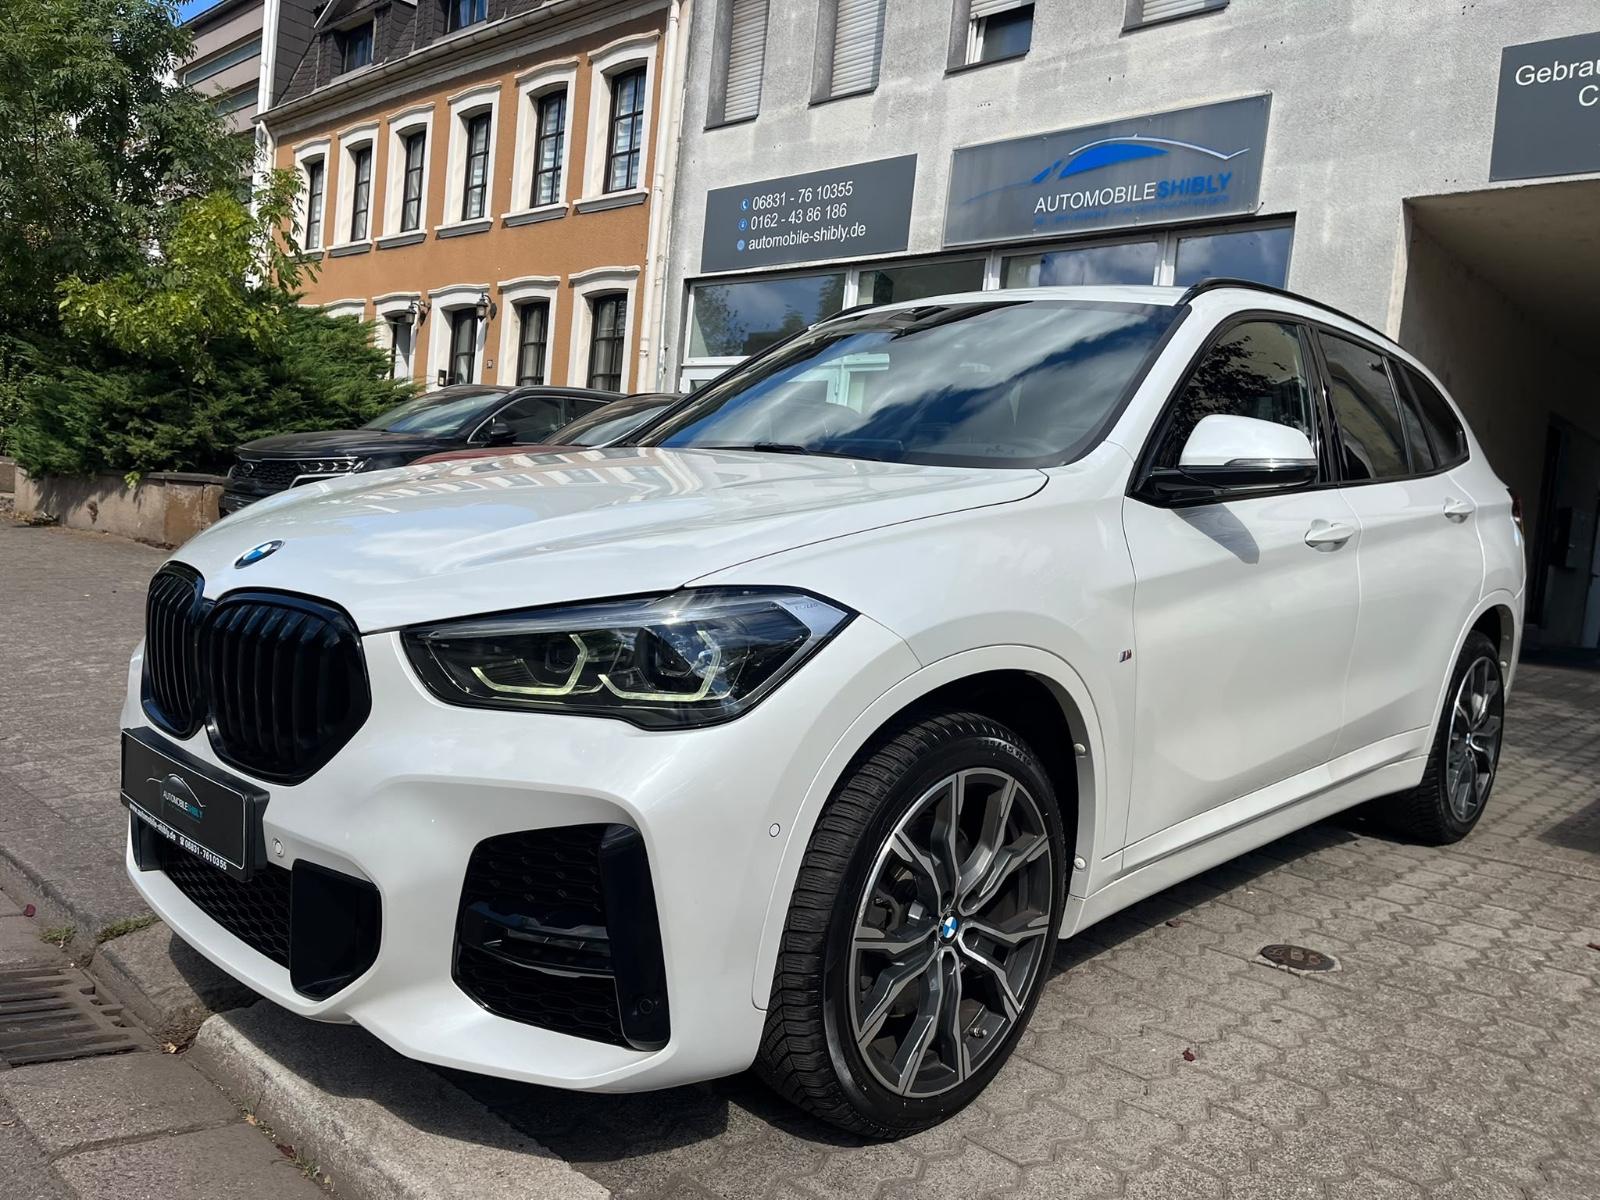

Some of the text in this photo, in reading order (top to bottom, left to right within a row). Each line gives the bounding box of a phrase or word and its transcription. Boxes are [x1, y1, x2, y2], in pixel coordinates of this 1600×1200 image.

[752, 193, 786, 211] 06831
[798, 187, 812, 204] 76
[816, 181, 853, 200] 10355
[750, 212, 778, 230] 0162
[788, 209, 803, 225] 43
[806, 206, 821, 223] 86
[825, 202, 847, 220] 186
[748, 222, 866, 250] automobile-shibly.de
